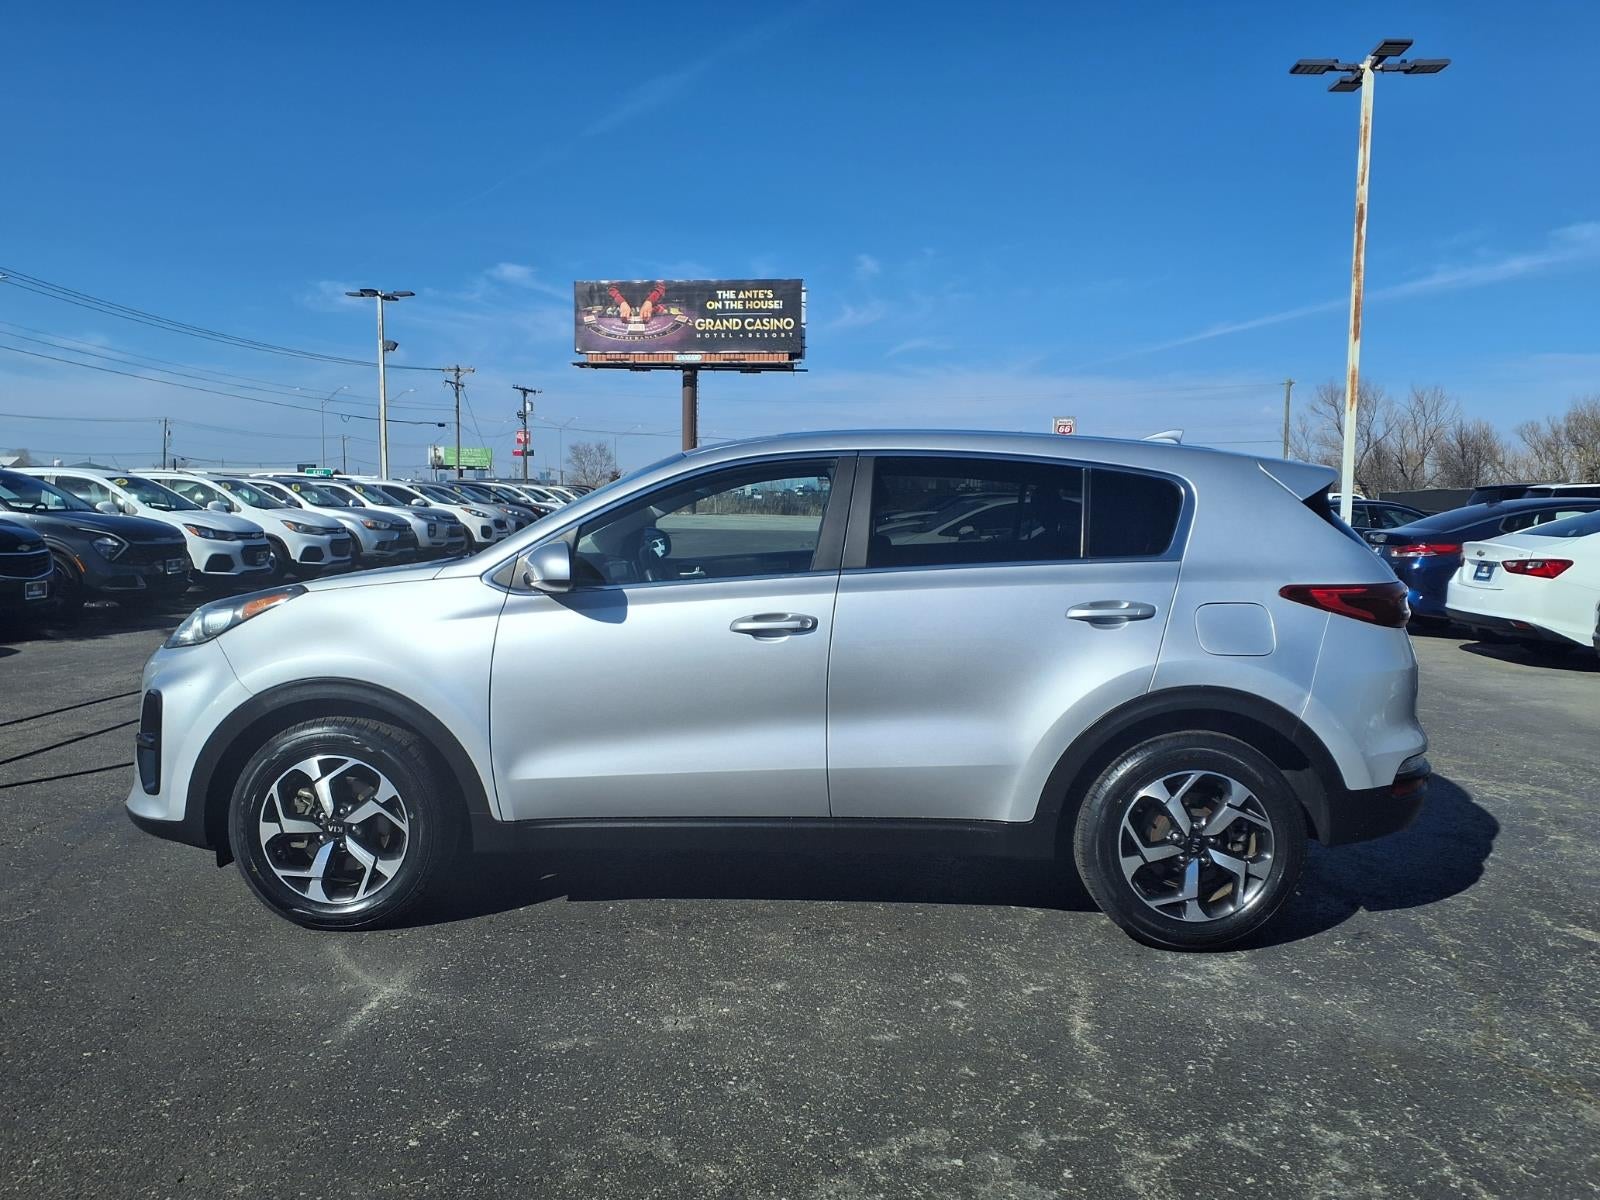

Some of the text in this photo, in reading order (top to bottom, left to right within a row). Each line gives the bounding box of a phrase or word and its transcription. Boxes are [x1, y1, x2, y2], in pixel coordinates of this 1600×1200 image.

[716, 289, 774, 299] THE ANTE'S
[706, 300, 783, 309] ON THE HOUSE!
[694, 317, 795, 330] GRAND CASINO
[327, 825, 343, 833] KIA
